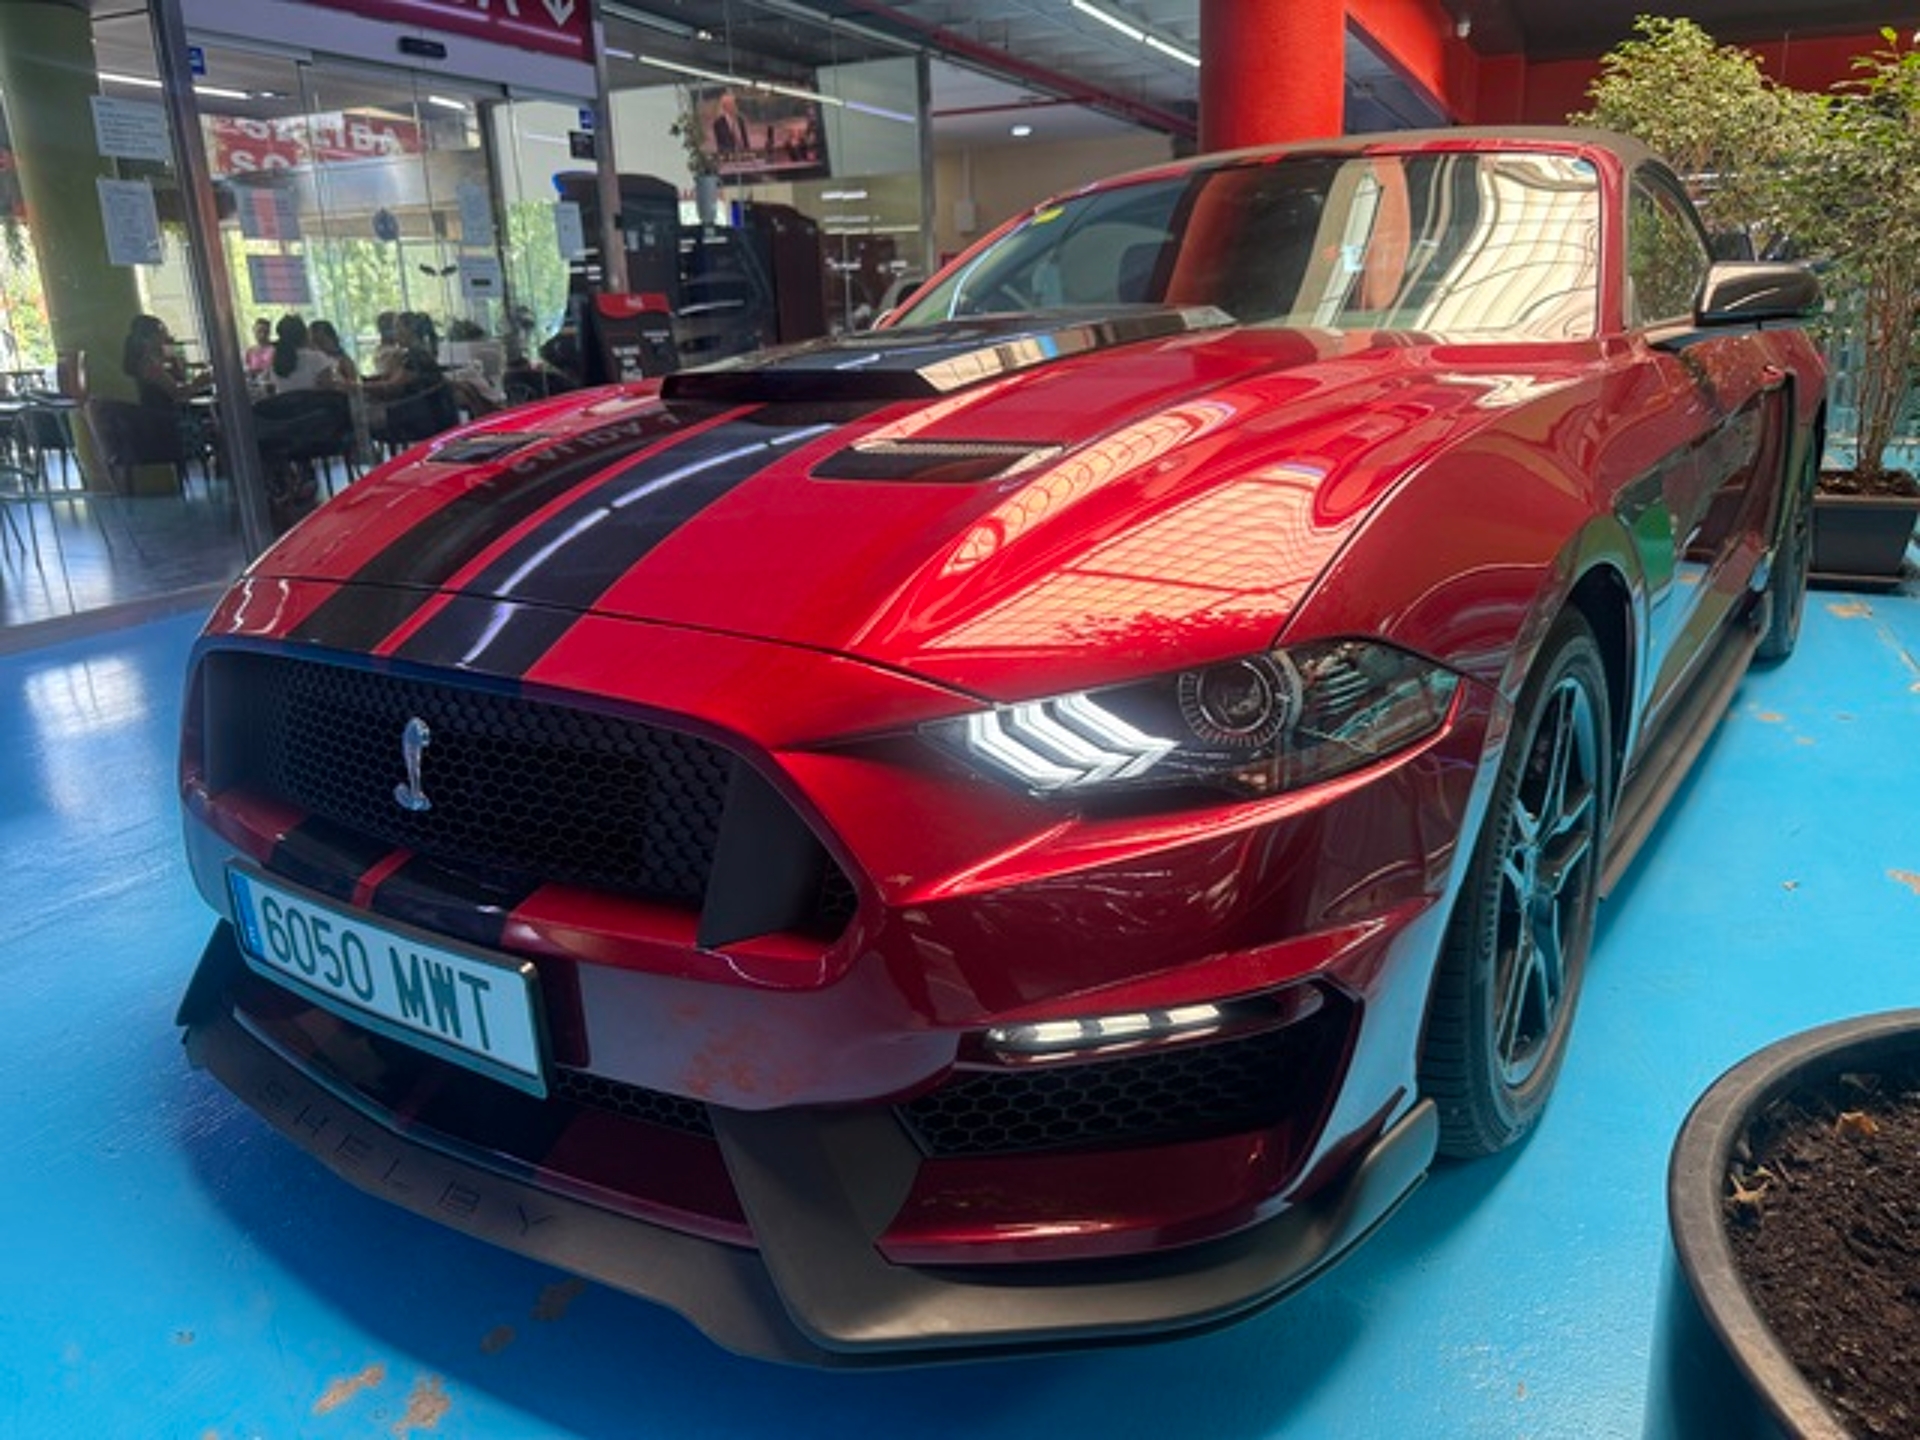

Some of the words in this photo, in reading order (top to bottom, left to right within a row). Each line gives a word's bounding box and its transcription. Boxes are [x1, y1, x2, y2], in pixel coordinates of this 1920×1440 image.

[261, 896, 374, 1001] 6050
[389, 946, 490, 1050] MWT
[257, 1079, 554, 1237] SHELBY
